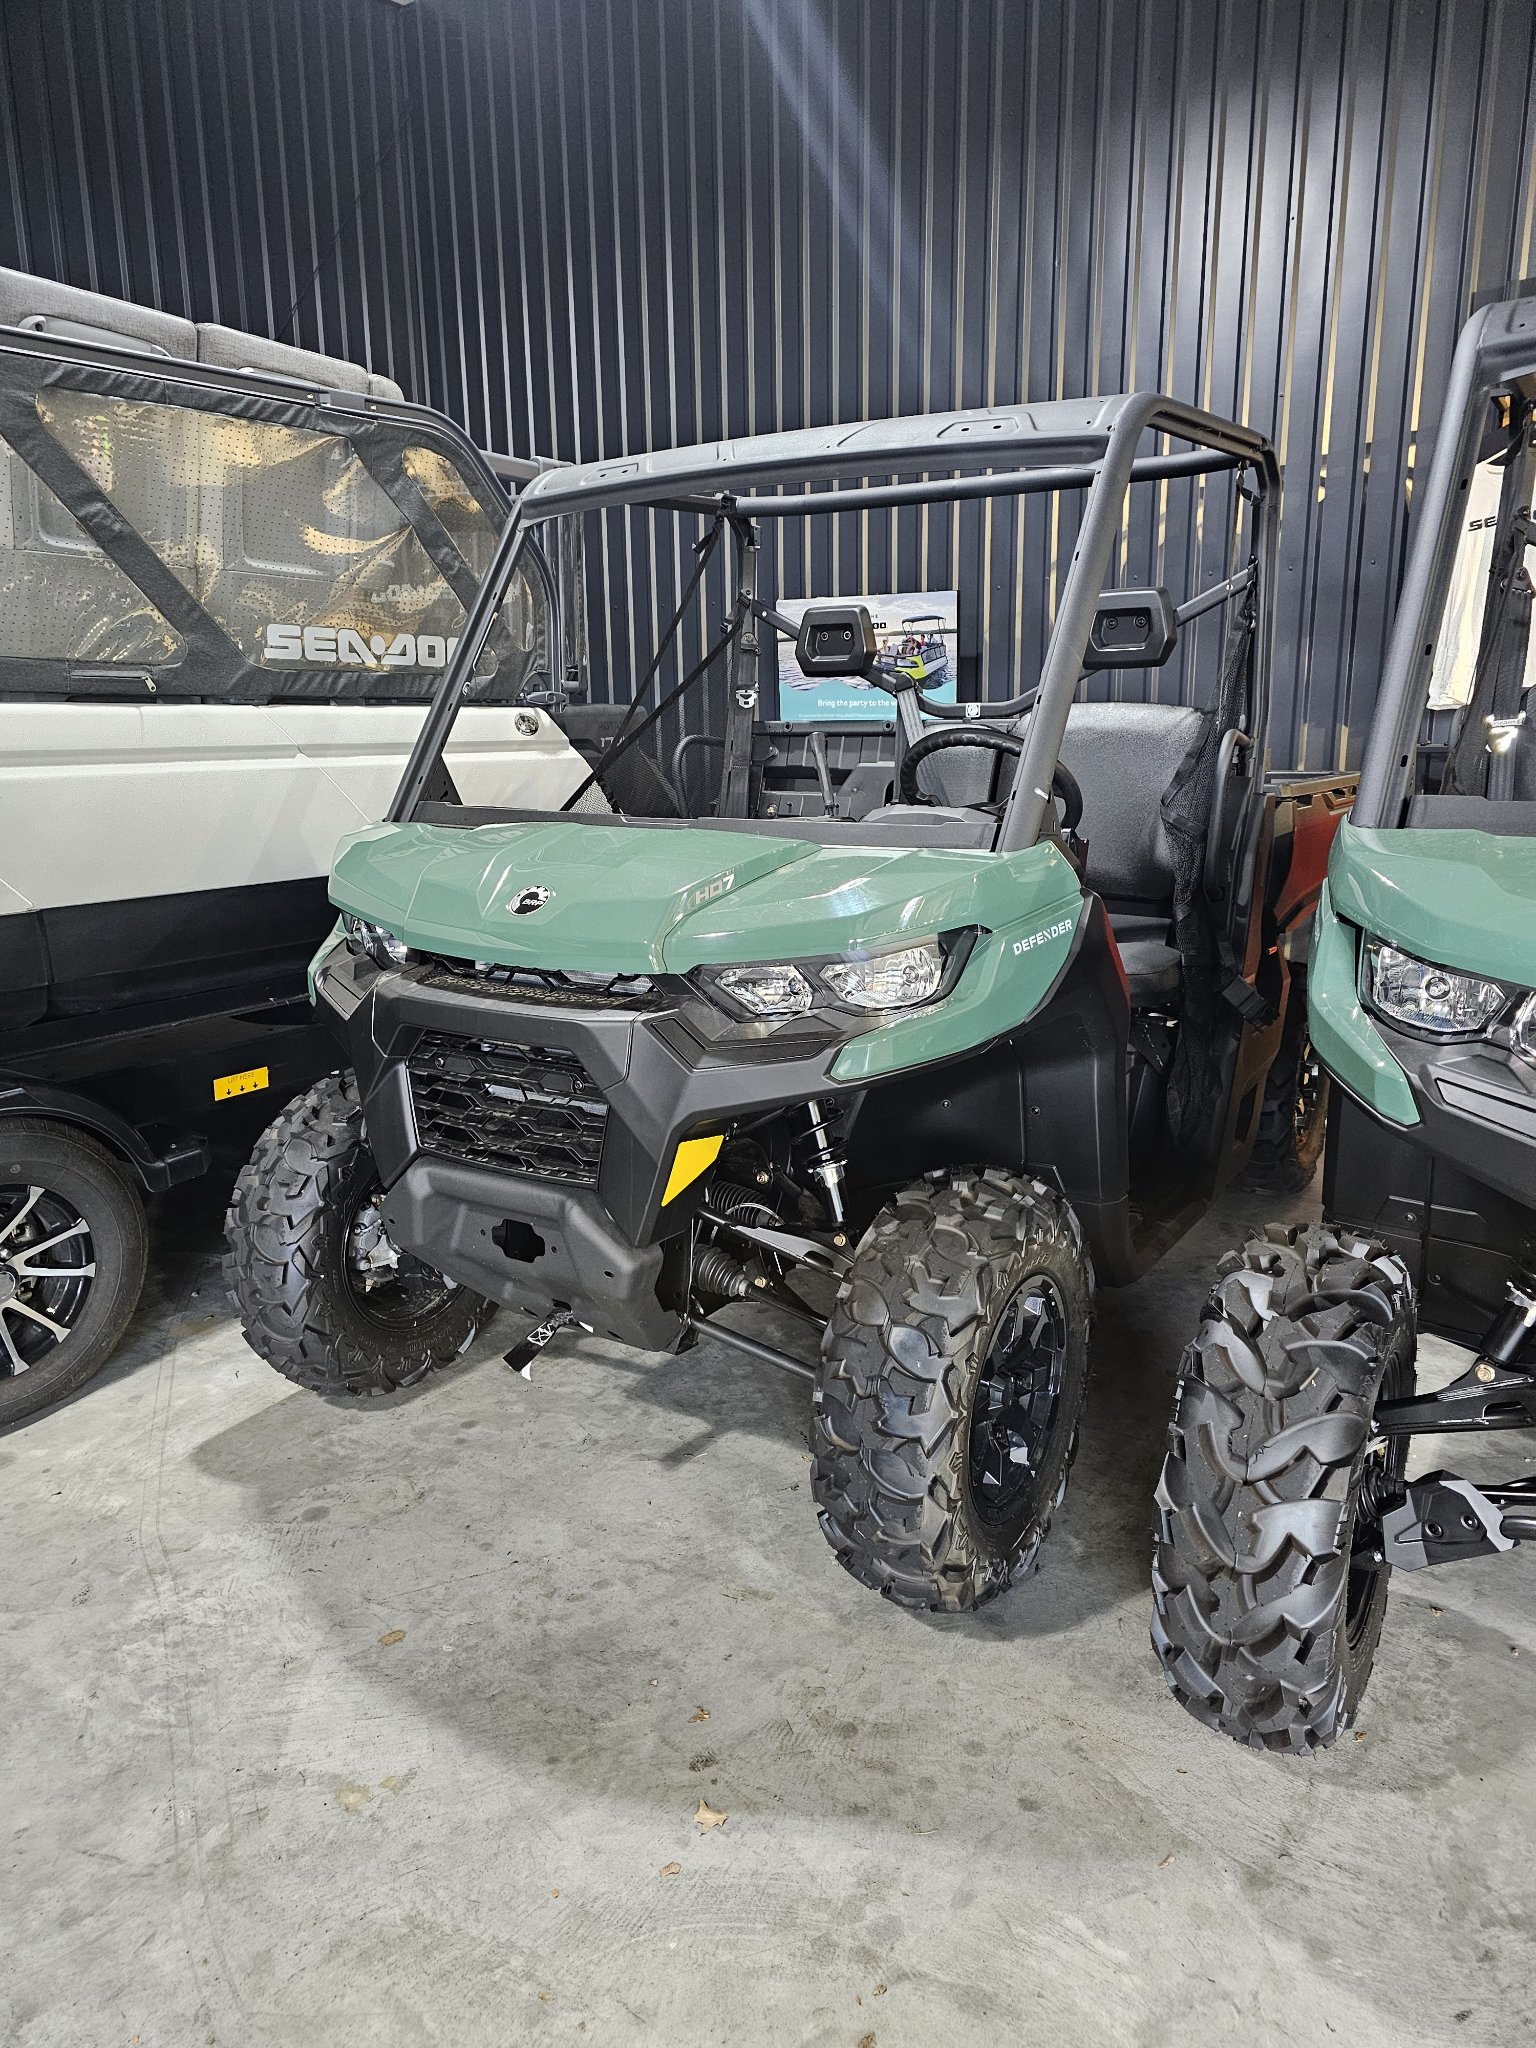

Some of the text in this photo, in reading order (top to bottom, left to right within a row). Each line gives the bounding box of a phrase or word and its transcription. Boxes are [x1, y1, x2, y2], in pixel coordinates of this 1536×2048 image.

[817, 699, 836, 709] Bring
[837, 699, 848, 707] the
[849, 700, 868, 708] party
[879, 699, 890, 707] the
[695, 873, 735, 905] HD7
[521, 898, 545, 906] BRP
[1013, 918, 1073, 956] DEFENDER
